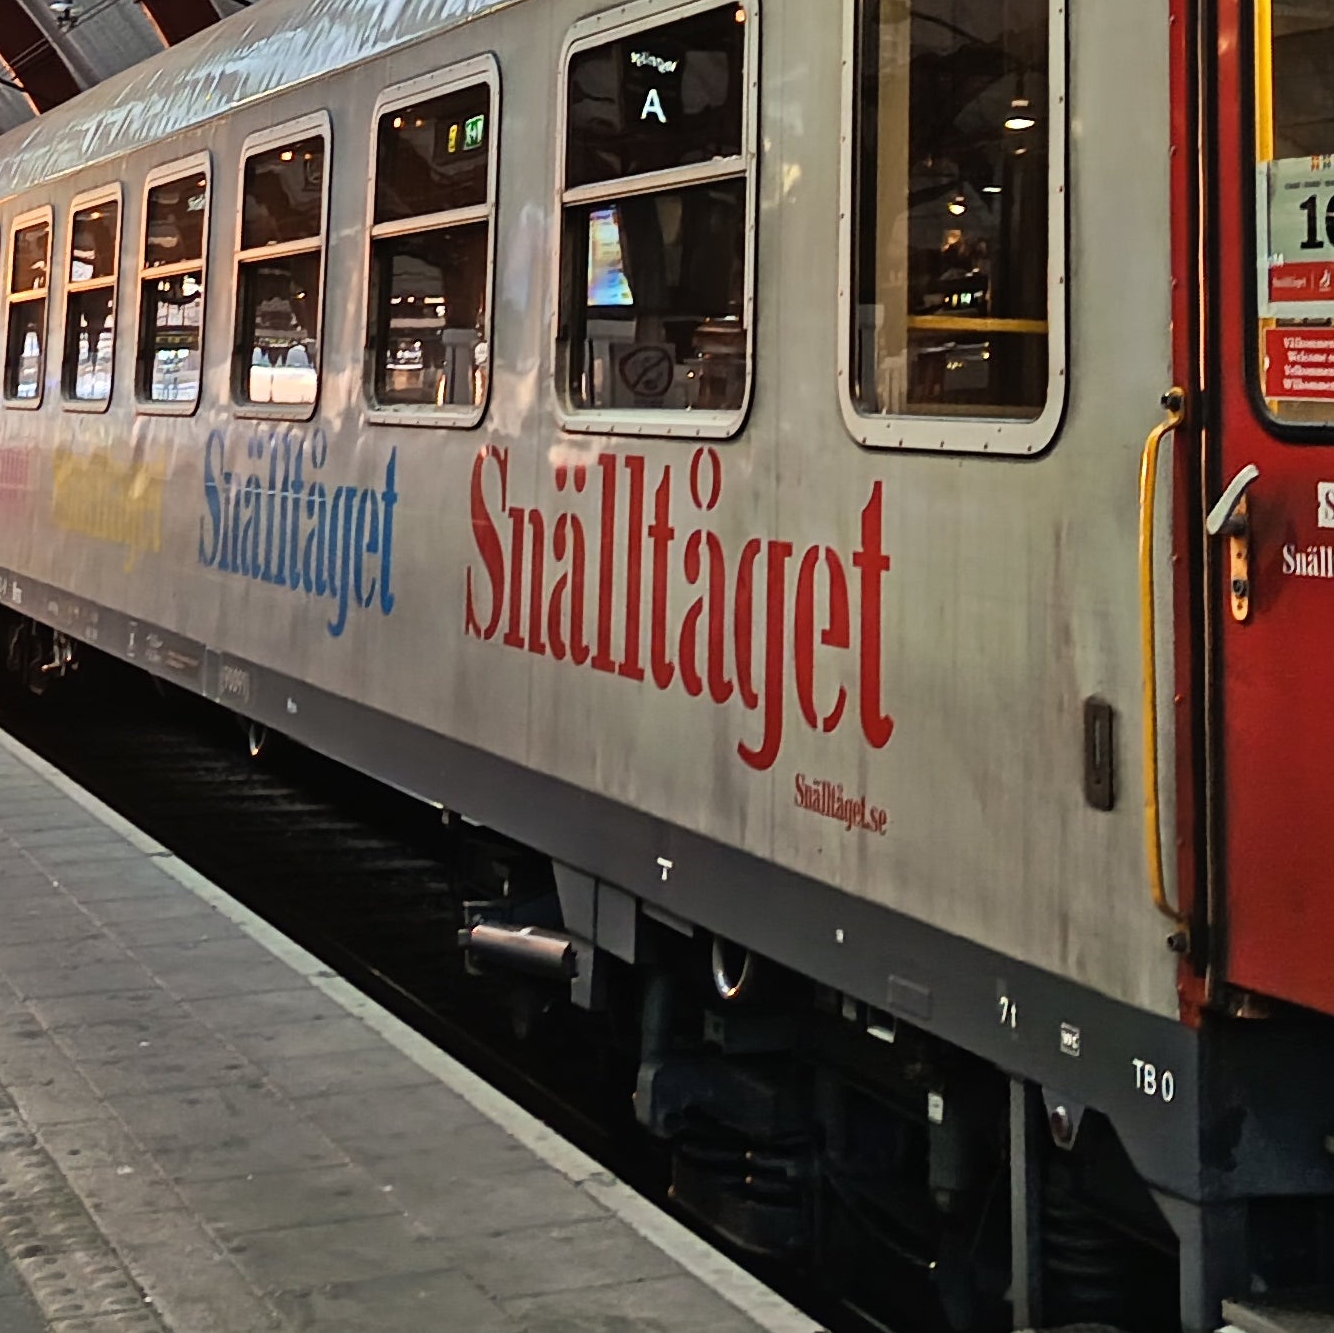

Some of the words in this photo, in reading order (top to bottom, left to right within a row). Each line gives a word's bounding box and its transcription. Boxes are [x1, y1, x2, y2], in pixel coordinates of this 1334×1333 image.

[198, 428, 398, 637] Snälltåget
[466, 444, 895, 770] Snälltåget
[794, 772, 888, 836] Snälltåget.se
